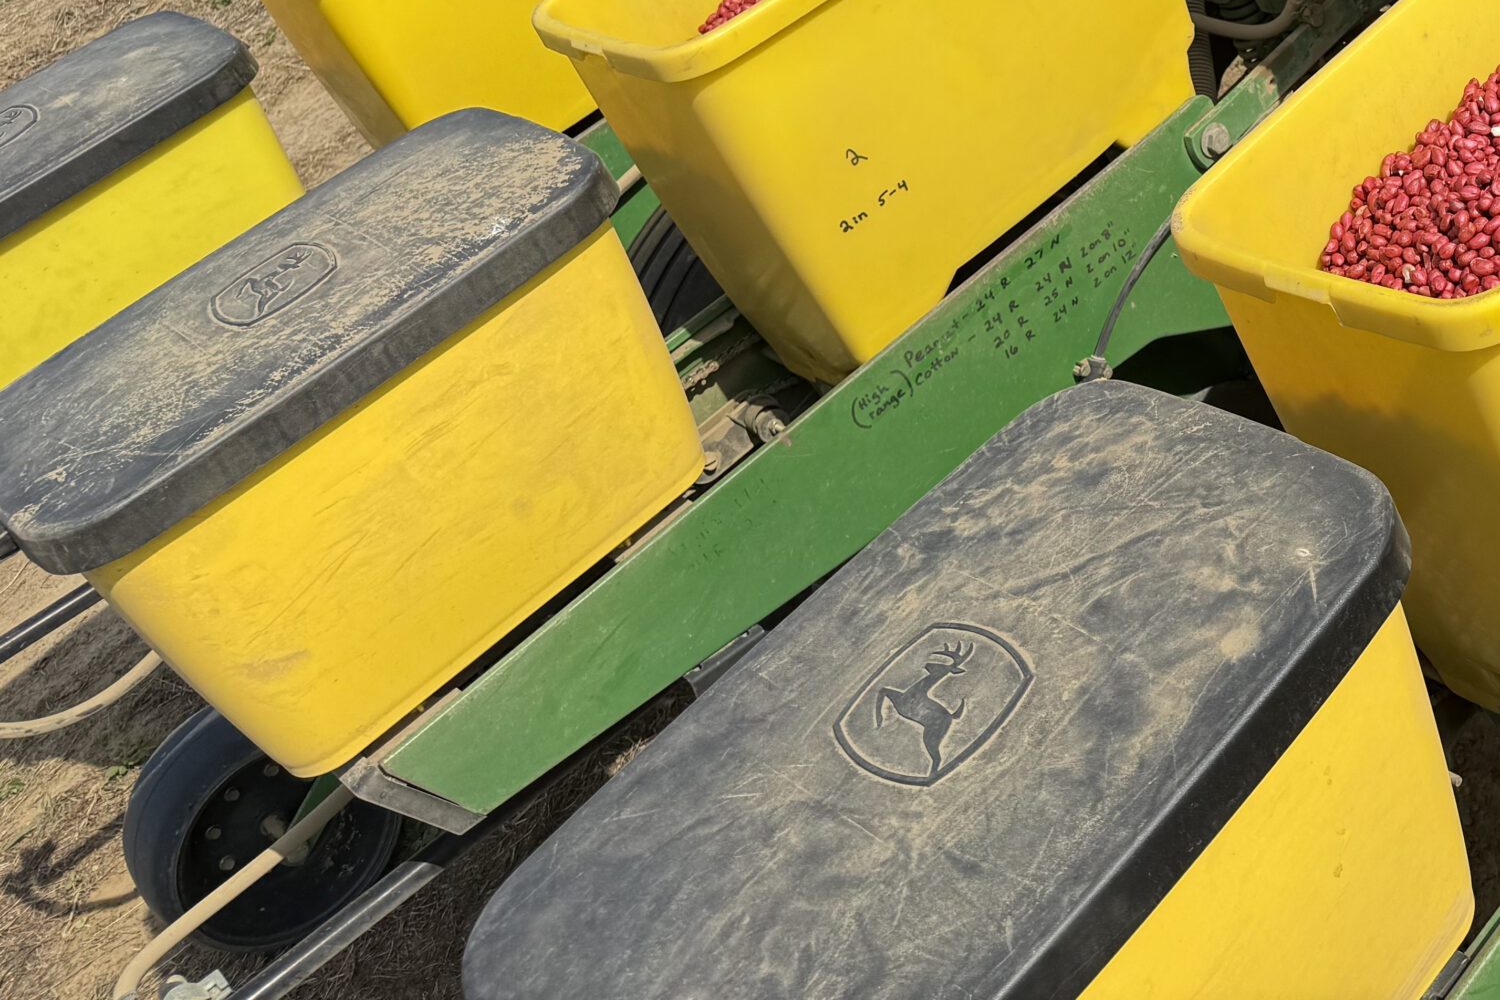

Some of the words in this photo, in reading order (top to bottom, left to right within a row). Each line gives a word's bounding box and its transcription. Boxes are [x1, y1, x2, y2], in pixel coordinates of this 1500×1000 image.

[845, 148, 869, 166] 2
[878, 179, 909, 207] 5-4
[1000, 276, 1012, 290] R
[1024, 248, 1044, 270] 27
[1051, 233, 1060, 249] N
[915, 347, 960, 386] Cotton
[984, 312, 1003, 332] 24
[1008, 300, 1020, 313] R
[1035, 272, 1052, 292] 24
[1059, 256, 1072, 274] N
[993, 329, 1010, 349] 20
[1017, 316, 1029, 328] R
[1044, 288, 1059, 306] 25
[1065, 275, 1073, 288] N
[1004, 344, 1018, 359] 16
[1025, 329, 1036, 342] R
[1053, 304, 1067, 323] 24
[1071, 296, 1079, 307] N
[1104, 265, 1118, 278] on
